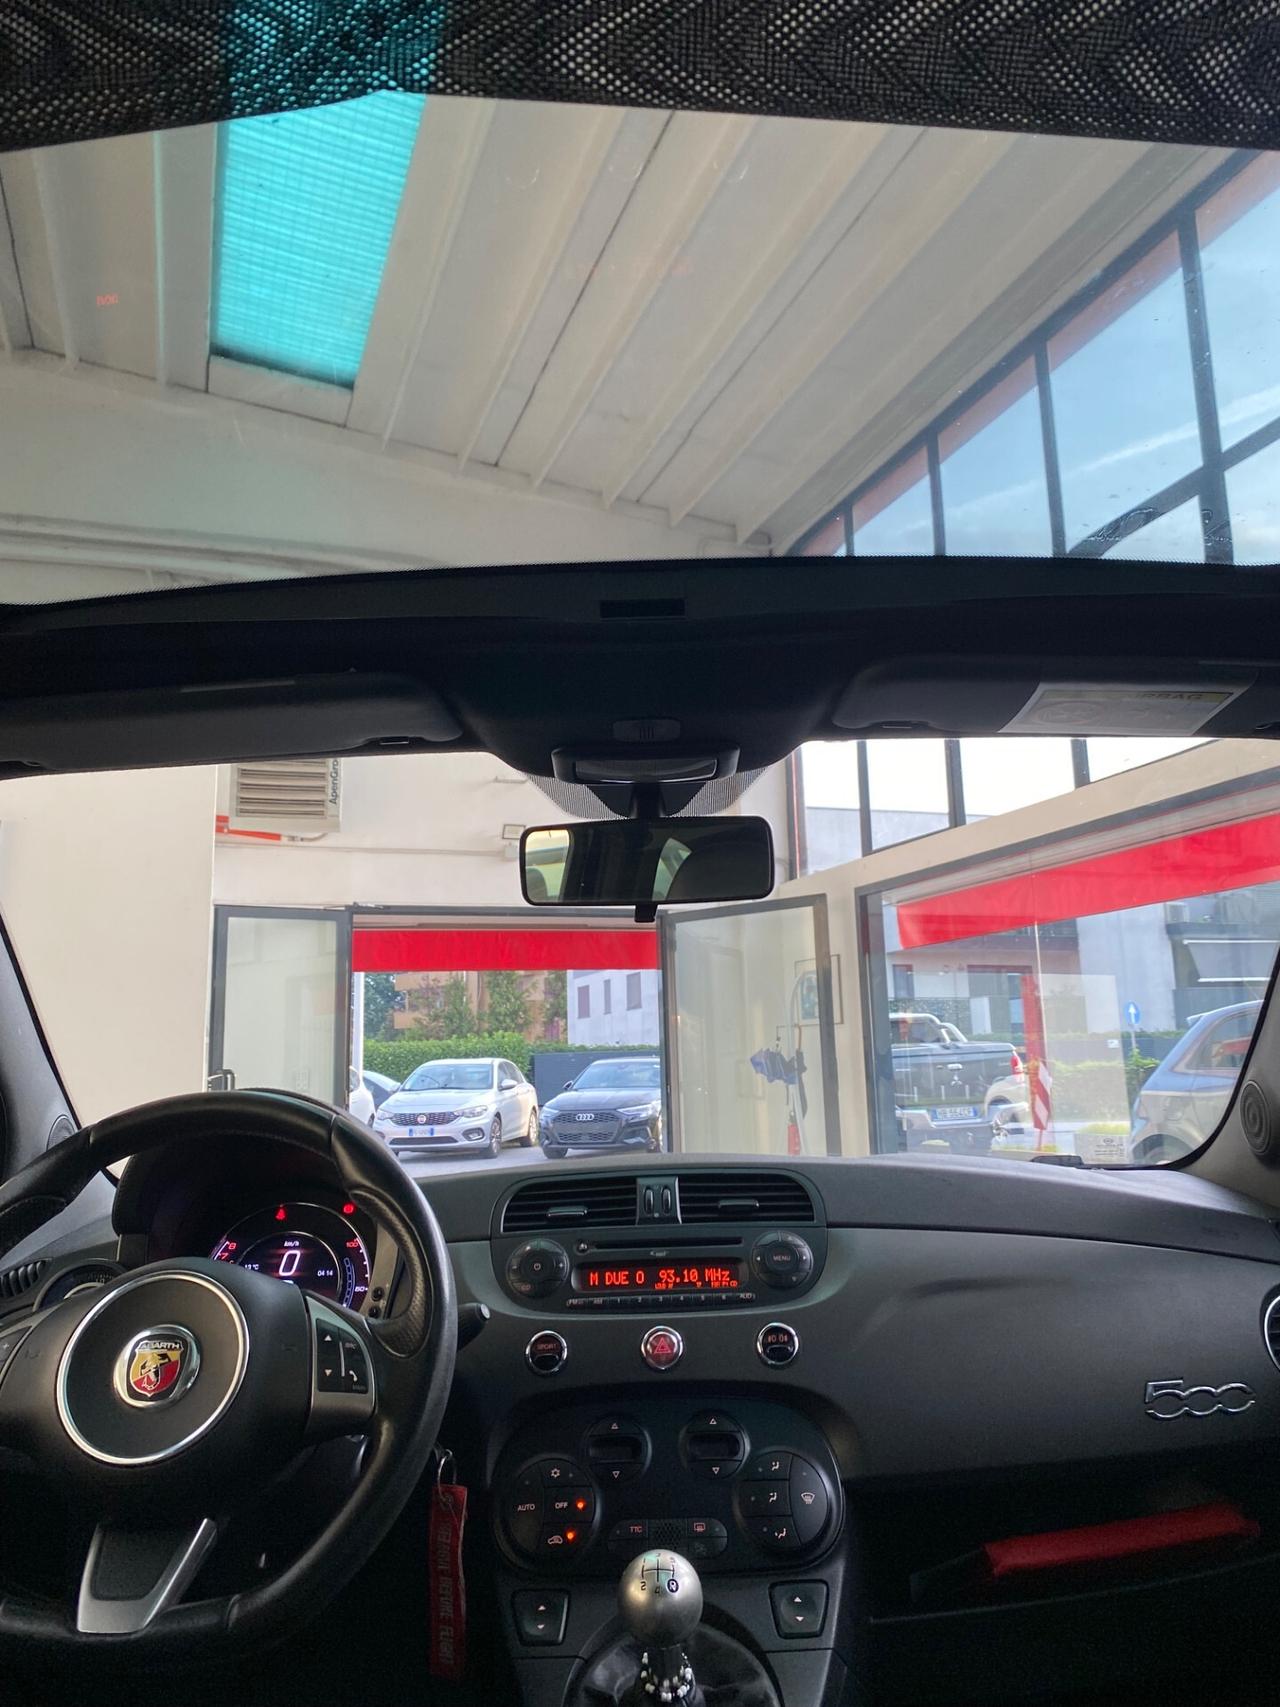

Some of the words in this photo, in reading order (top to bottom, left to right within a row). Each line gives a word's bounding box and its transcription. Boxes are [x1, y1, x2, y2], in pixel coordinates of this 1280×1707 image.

[278, 1250, 301, 1276] 0
[590, 1271, 599, 1286] M
[605, 1270, 629, 1285] DUE
[658, 1269, 699, 1283] 93.10
[705, 1268, 730, 1282] MHz
[1145, 1379, 1256, 1418] 500
